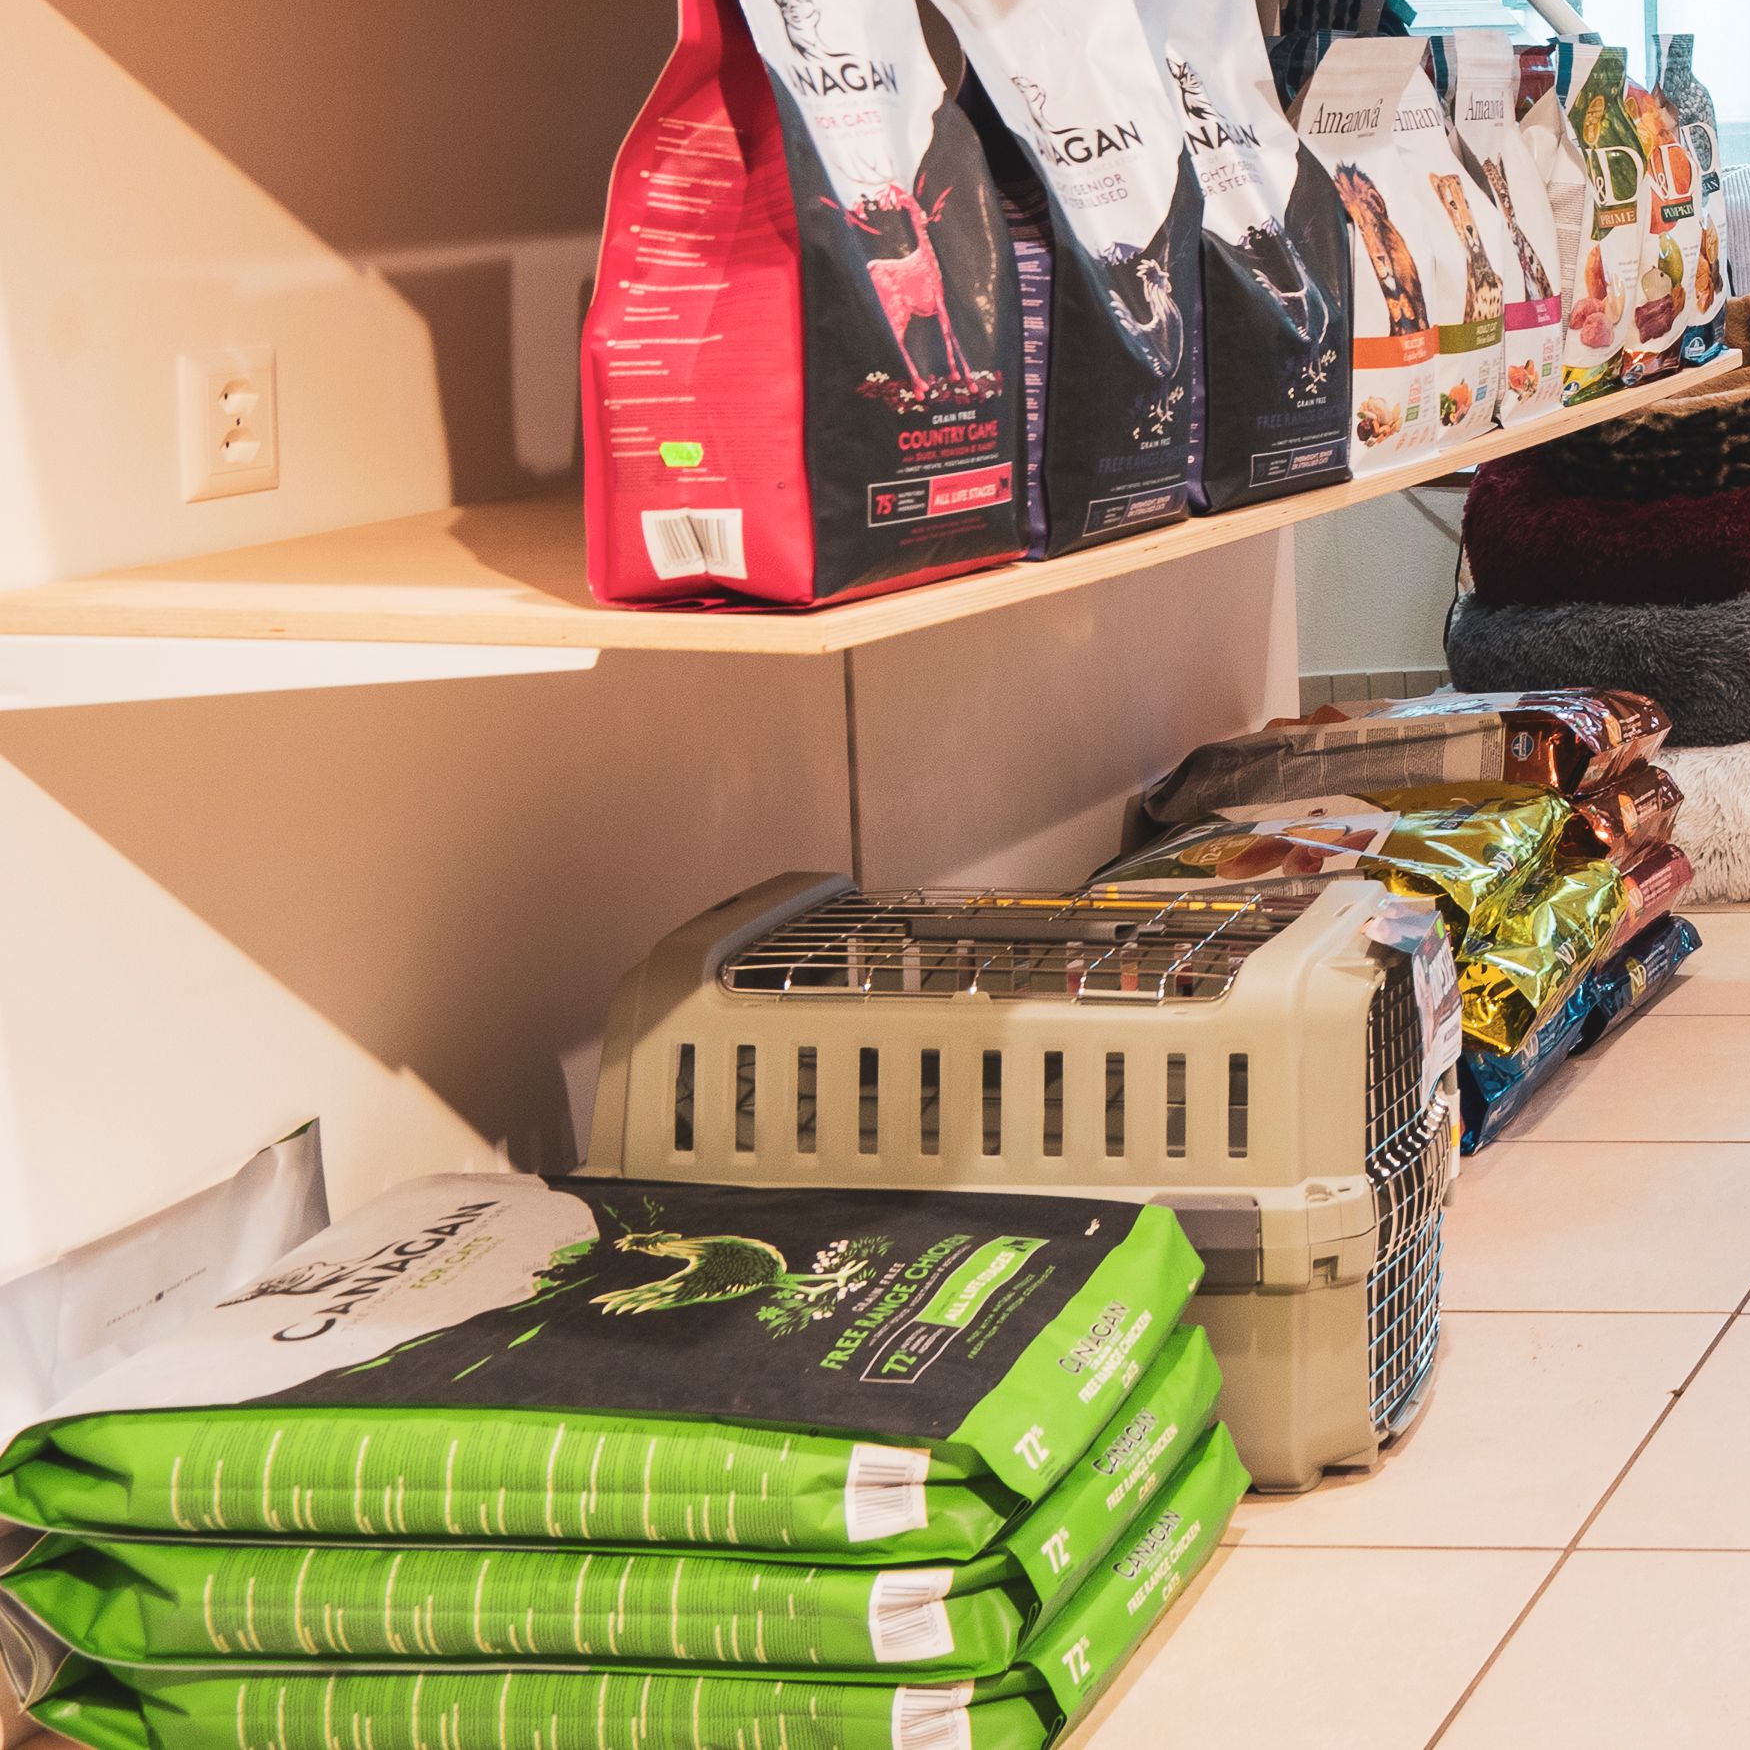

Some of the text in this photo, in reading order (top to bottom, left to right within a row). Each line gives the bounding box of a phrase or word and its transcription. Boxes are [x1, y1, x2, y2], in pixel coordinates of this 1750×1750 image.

[1600, 210, 1637, 227] PRIME
[898, 420, 1000, 451] COUNTRY GAME
[273, 1199, 501, 1342] CANAGAN
[410, 1235, 494, 1291] FOR CATS
[820, 1234, 975, 1372] FREE RANGE CHICKEN
[1093, 1408, 1158, 1478] CANAGAN
[1112, 1509, 1182, 1581] CANAGAN
